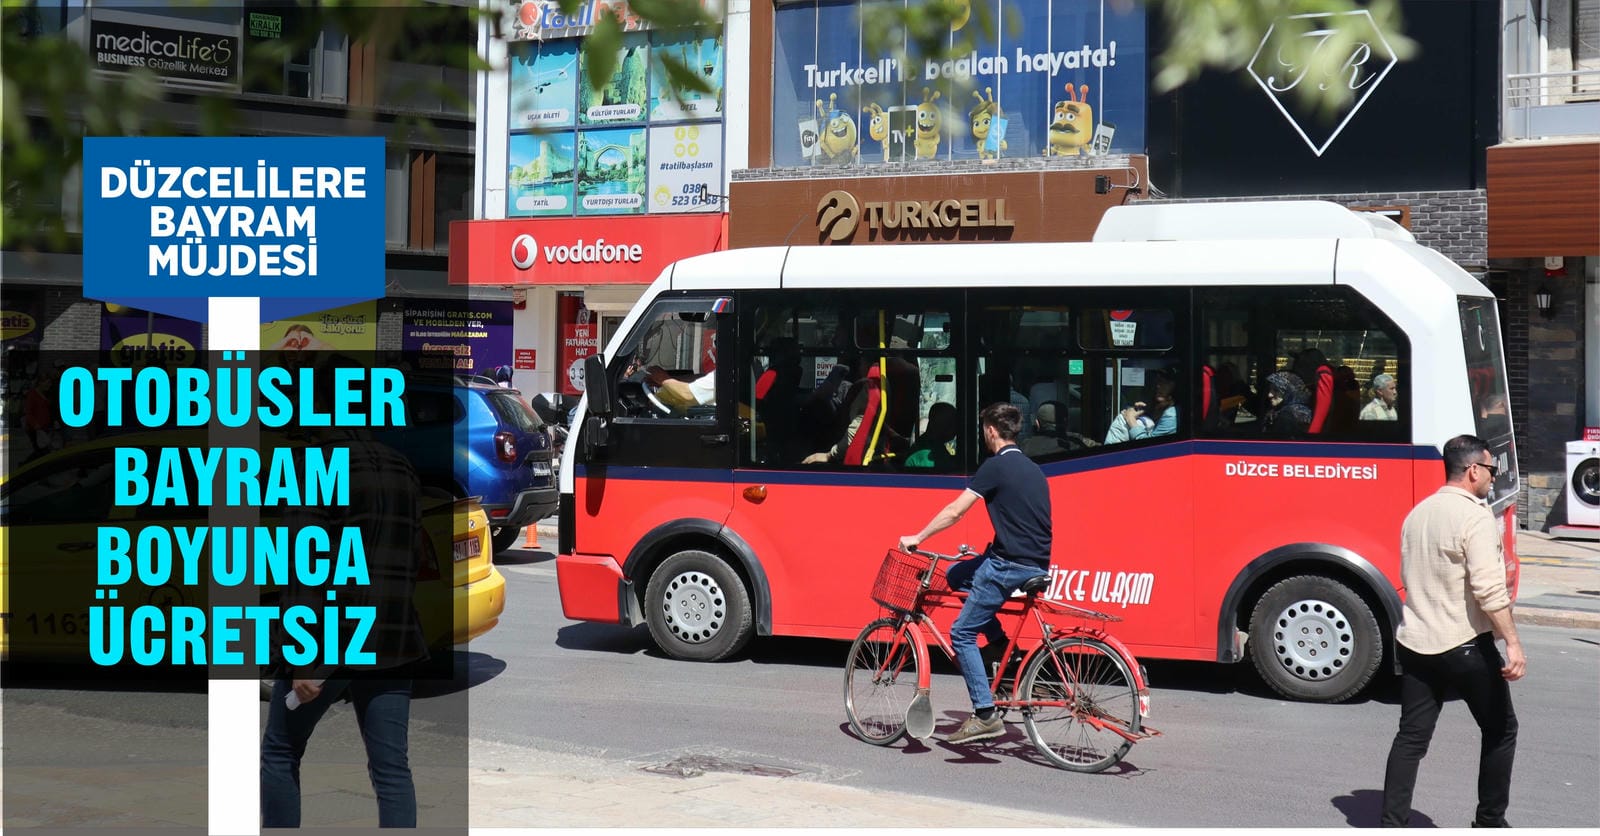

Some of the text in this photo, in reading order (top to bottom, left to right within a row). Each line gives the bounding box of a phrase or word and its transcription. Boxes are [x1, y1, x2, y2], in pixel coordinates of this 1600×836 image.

[97, 52, 228, 77] BUSINESS Güzellik Merkezi
[804, 58, 917, 88] Turkcell'l
[1016, 40, 1117, 76] hayata!
[543, 111, 560, 120] BİLETİ
[590, 107, 637, 118] KÜLTÜR TURLARI
[660, 161, 713, 172] #tatilbaşlasın
[682, 184, 706, 194] 038
[533, 197, 549, 207] TATİL
[613, 196, 638, 205] TURLAR
[672, 195, 690, 206] 523
[863, 198, 1015, 229] TURKCELL
[544, 238, 642, 263] vodafone
[575, 347, 588, 356] HAT
[1225, 460, 1378, 480] DÜZCE BELEDİYESİ
[1091, 570, 1155, 609] ULAŞIM
